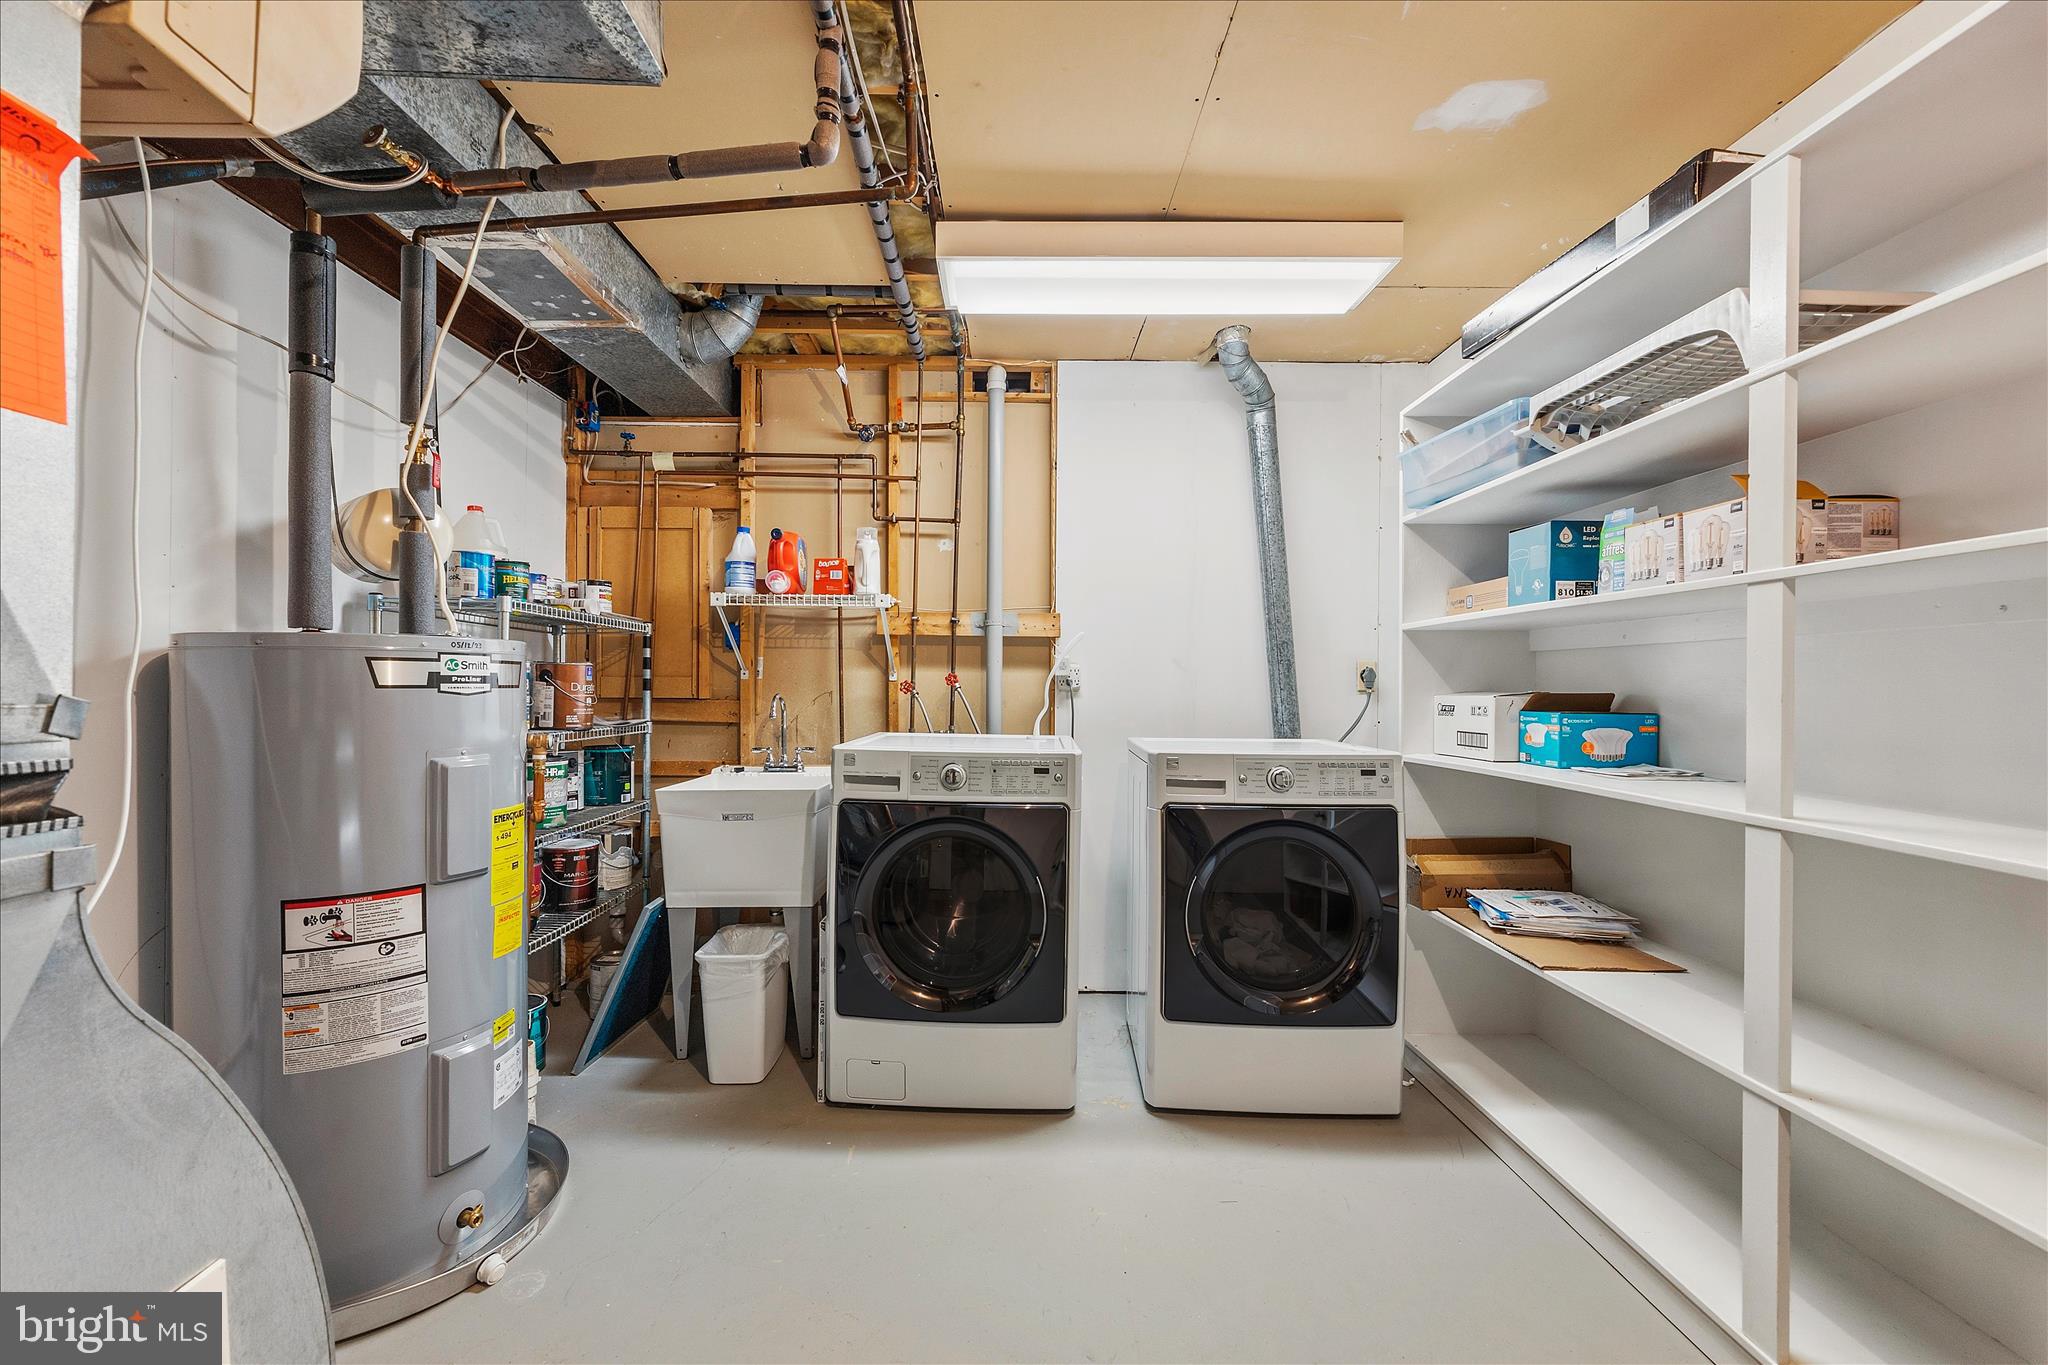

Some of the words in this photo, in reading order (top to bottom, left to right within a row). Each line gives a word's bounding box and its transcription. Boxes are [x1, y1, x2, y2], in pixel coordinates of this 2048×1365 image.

[1601, 544, 1625, 557] affres
[818, 559, 840, 567] bounce
[1558, 589, 1575, 597] 810
[1576, 589, 1594, 597] $1.20
